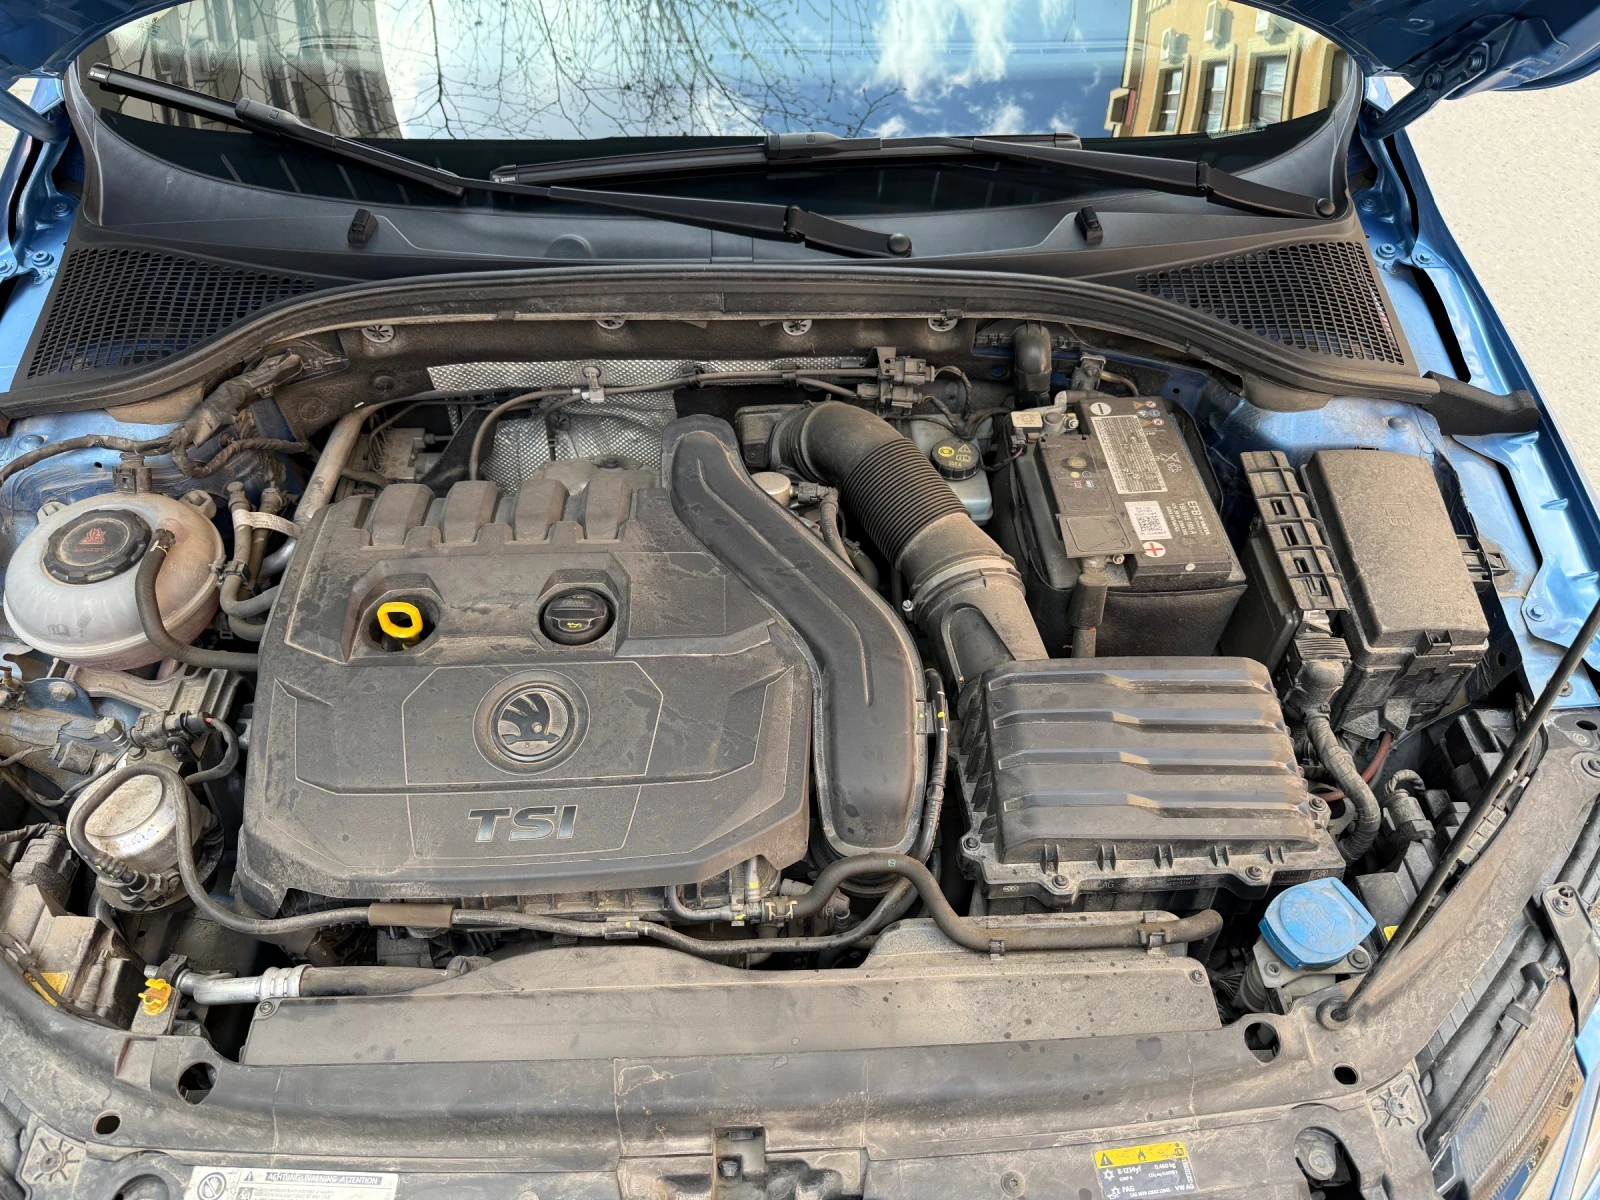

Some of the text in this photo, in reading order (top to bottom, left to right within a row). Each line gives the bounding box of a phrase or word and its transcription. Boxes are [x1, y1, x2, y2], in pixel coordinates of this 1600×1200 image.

[1187, 501, 1202, 516] EFB
[468, 805, 578, 842] TSI
[1117, 1165, 1142, 1175] R-1234yf
[267, 1172, 378, 1185] ACHTUNG WARNING ATTENTION
[1121, 1185, 1135, 1193] PAG
[1174, 1184, 1185, 1192] VW
